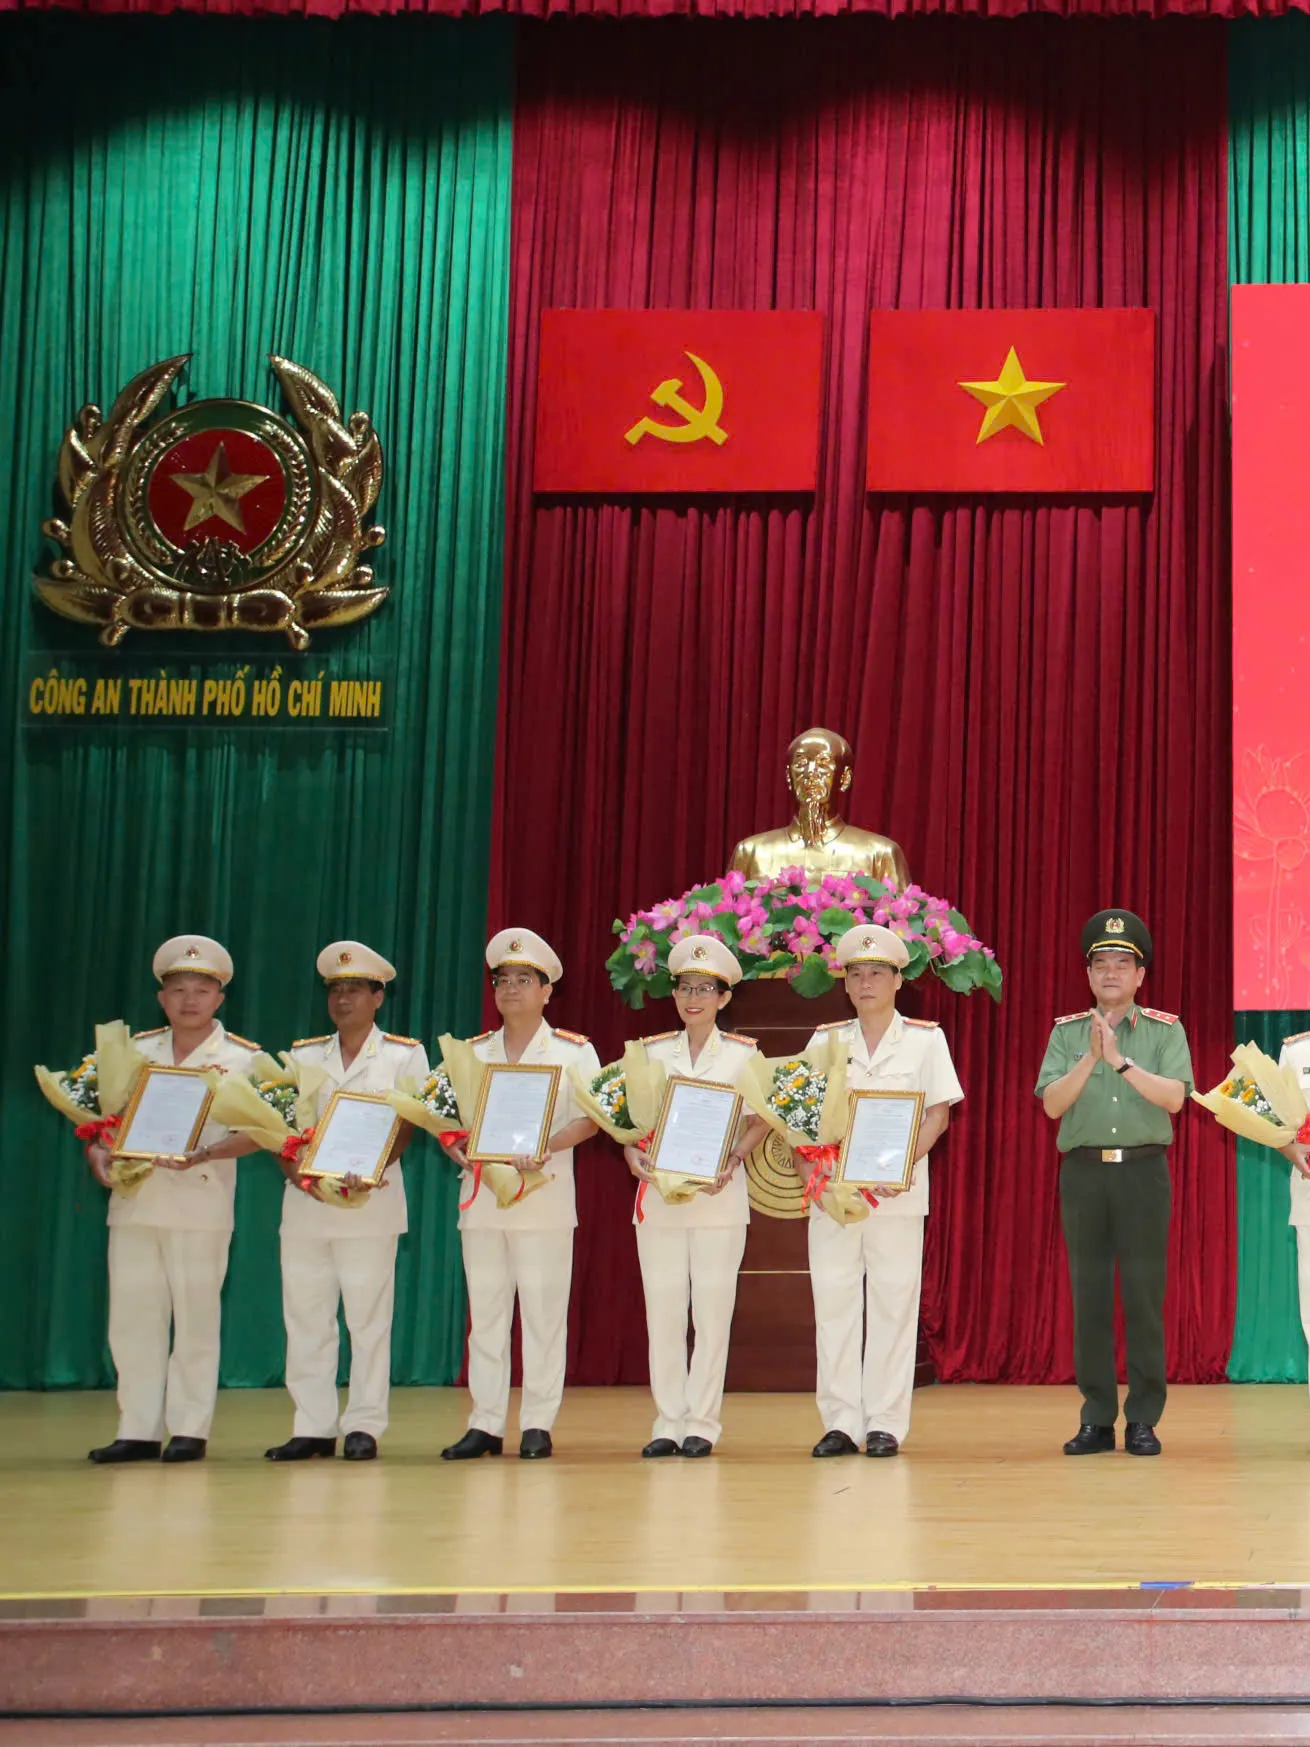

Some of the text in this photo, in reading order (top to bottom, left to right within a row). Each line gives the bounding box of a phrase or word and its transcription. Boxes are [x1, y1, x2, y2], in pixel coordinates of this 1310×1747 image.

[30, 664, 381, 718] CÔNG AN THÀNH PHỐ HỒ CHÍ MINH
